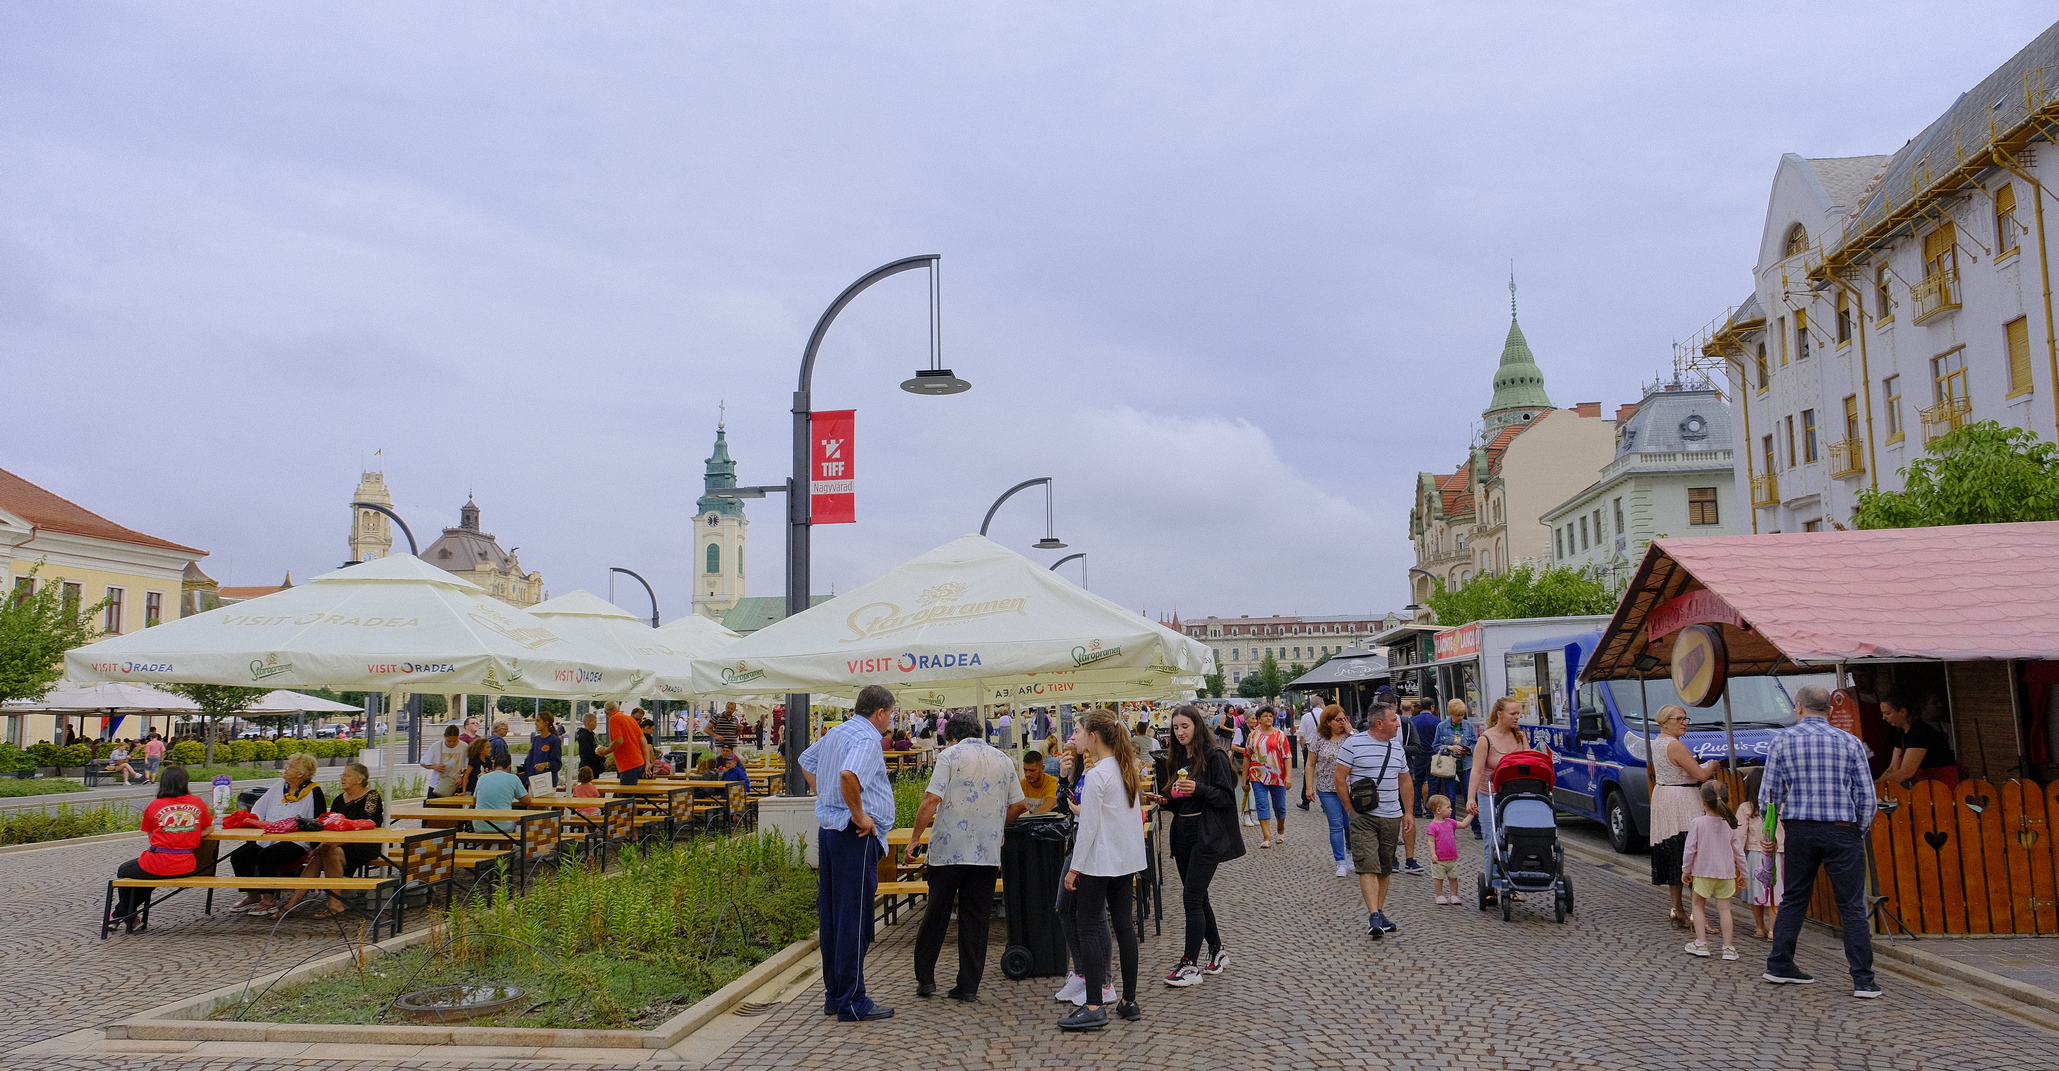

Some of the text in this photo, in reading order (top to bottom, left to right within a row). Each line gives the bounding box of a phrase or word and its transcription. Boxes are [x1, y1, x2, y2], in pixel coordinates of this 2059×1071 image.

[821, 461, 845, 477] TIFF
[813, 481, 853, 494] Nagyvárad
[221, 612, 420, 628] VISIT ORADEA
[838, 597, 1029, 643] Staropramen
[847, 652, 982, 674] VISIT ORADEA
[1071, 645, 1123, 668] Staropramen
[91, 661, 174, 674] VISIT ORADEA
[249, 659, 293, 682] Staropramen
[367, 661, 456, 674] VISIT ORADEA
[554, 667, 603, 684] VISIT ORADEA
[721, 667, 767, 686] Staropramen
